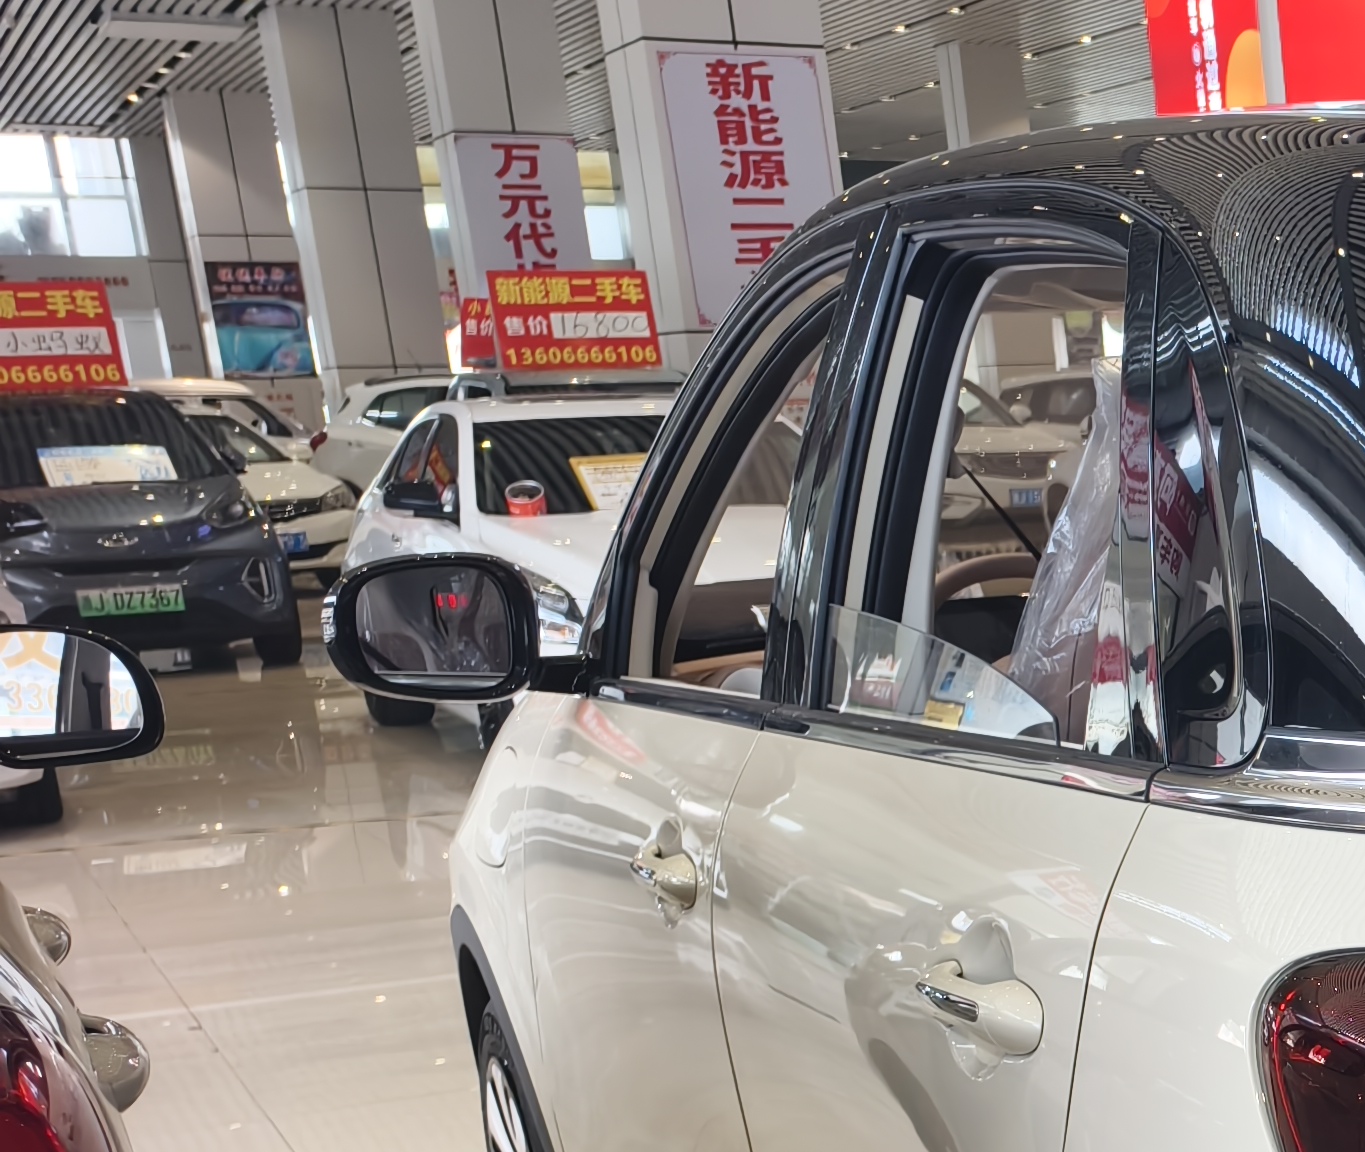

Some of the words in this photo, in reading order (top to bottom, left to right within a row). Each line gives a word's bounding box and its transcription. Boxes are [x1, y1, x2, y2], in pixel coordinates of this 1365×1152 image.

[705, 58, 795, 290] 新能源二手
[495, 276, 645, 305] 新能源二手车
[503, 314, 548, 336] 售价
[506, 345, 657, 366] 13606666106
[82, 587, 181, 612] JDZ7367
